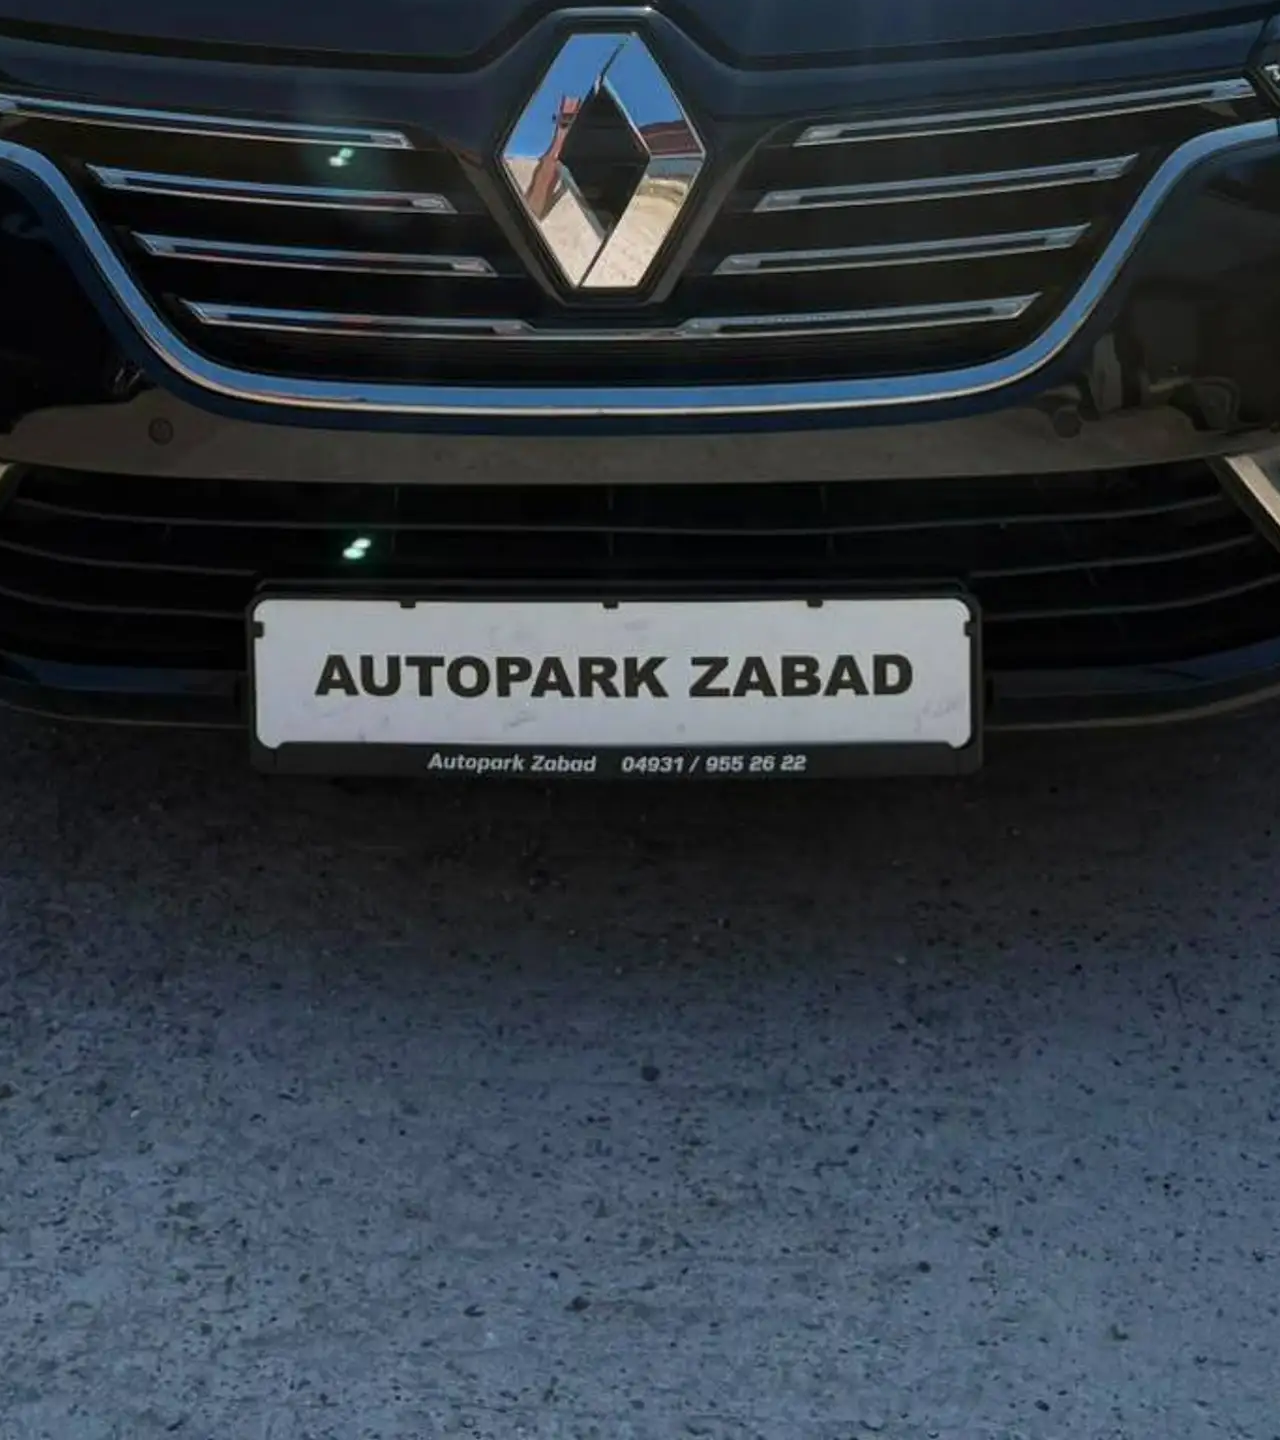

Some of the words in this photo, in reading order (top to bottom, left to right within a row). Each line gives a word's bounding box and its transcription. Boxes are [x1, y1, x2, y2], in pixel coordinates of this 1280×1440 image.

[315, 654, 669, 698] AUTOPARK
[688, 654, 915, 697] ZABAD
[426, 752, 524, 774] Autopark
[530, 755, 597, 772] Zabad
[622, 756, 684, 773] 04931
[688, 756, 701, 773] /
[705, 756, 744, 772] 955
[748, 756, 776, 772] 26
[780, 755, 807, 771] 22
